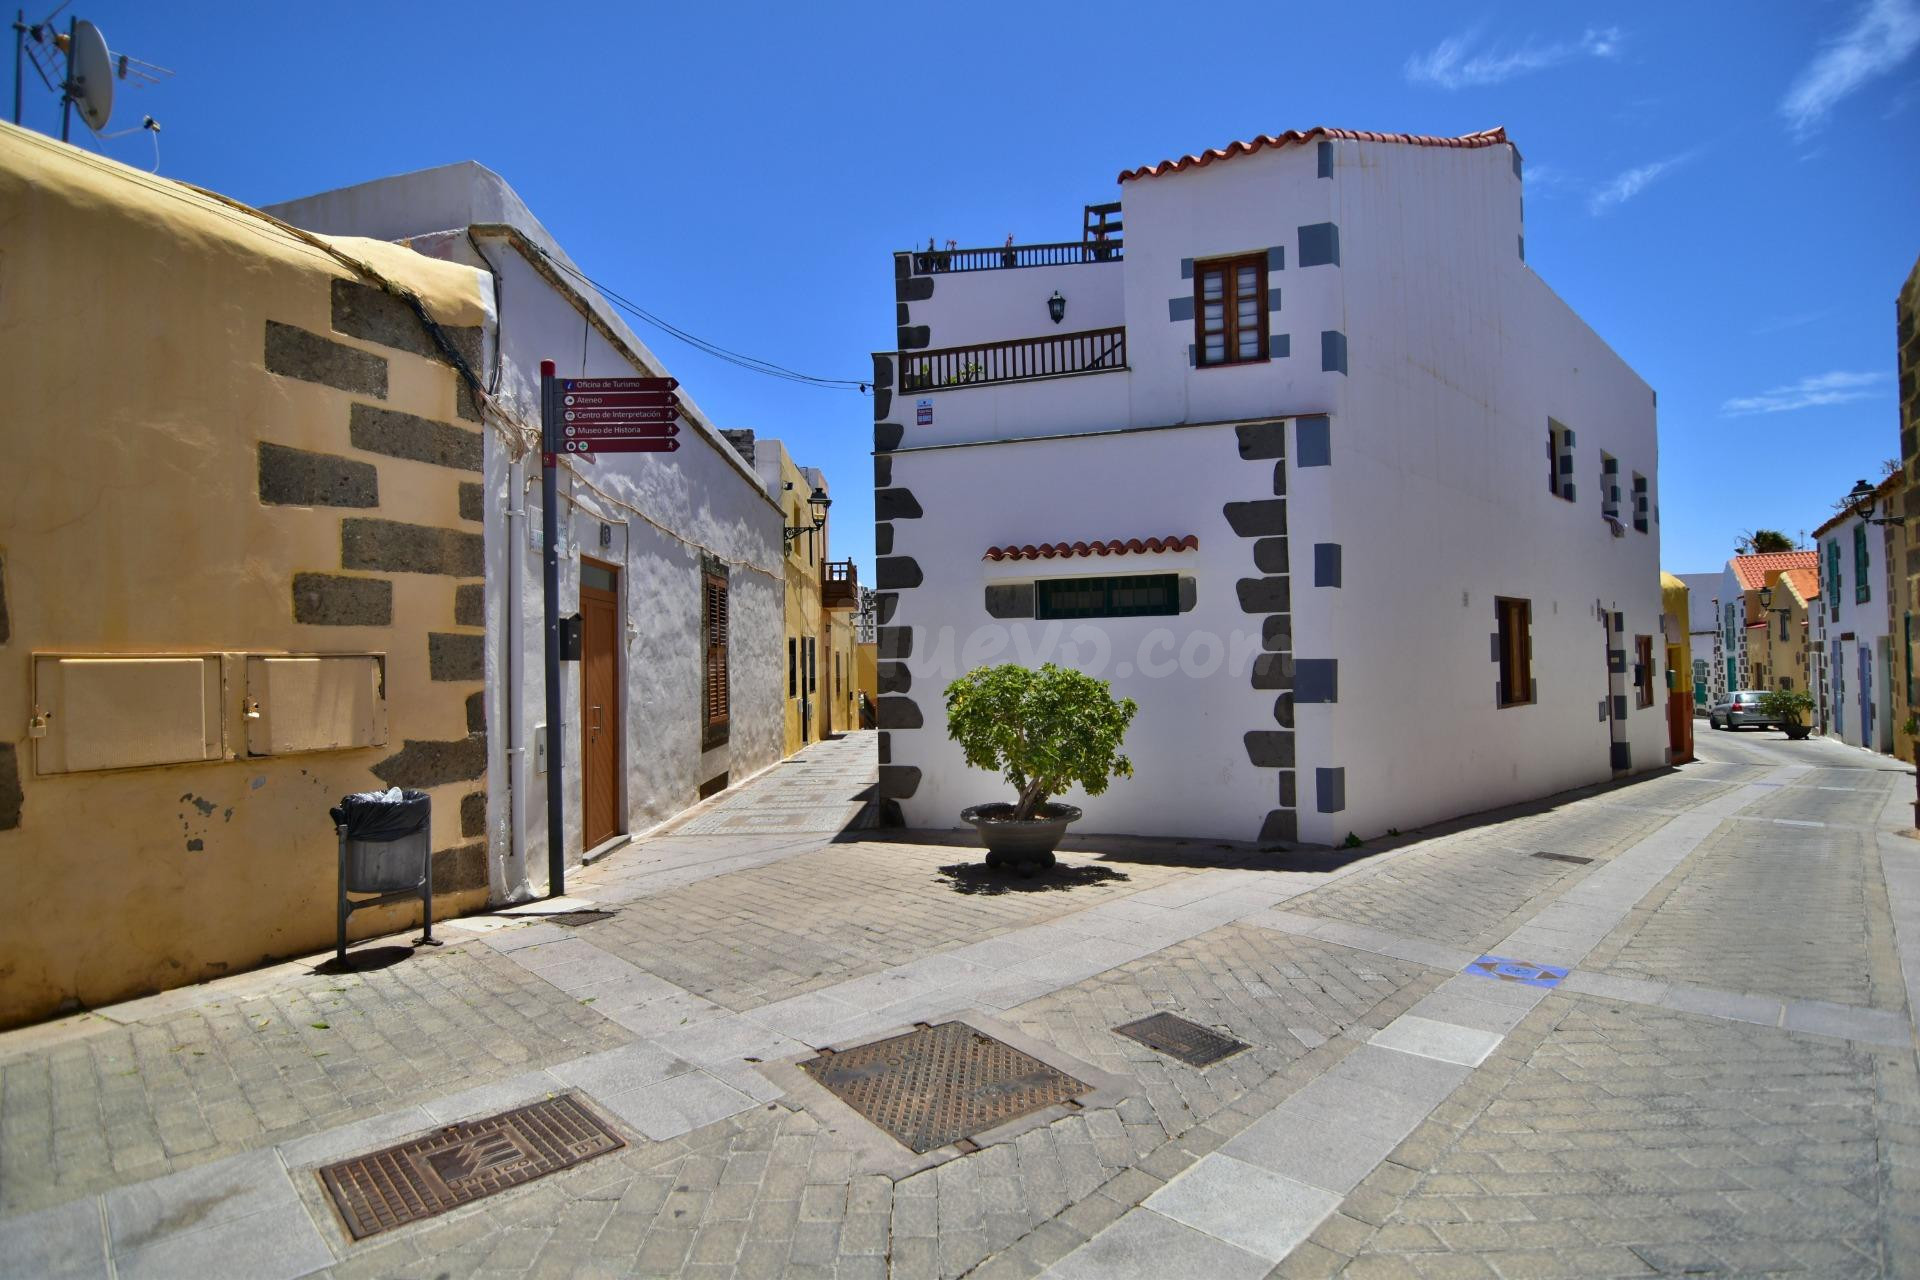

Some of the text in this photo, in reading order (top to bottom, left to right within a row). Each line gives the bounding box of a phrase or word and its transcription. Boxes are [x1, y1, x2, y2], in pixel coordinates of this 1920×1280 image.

[576, 380, 640, 389] Oficina de Turismo
[576, 396, 603, 404] Ateneo
[577, 409, 661, 420] Centro de Interpretación
[577, 425, 641, 434] Museo de Historia
